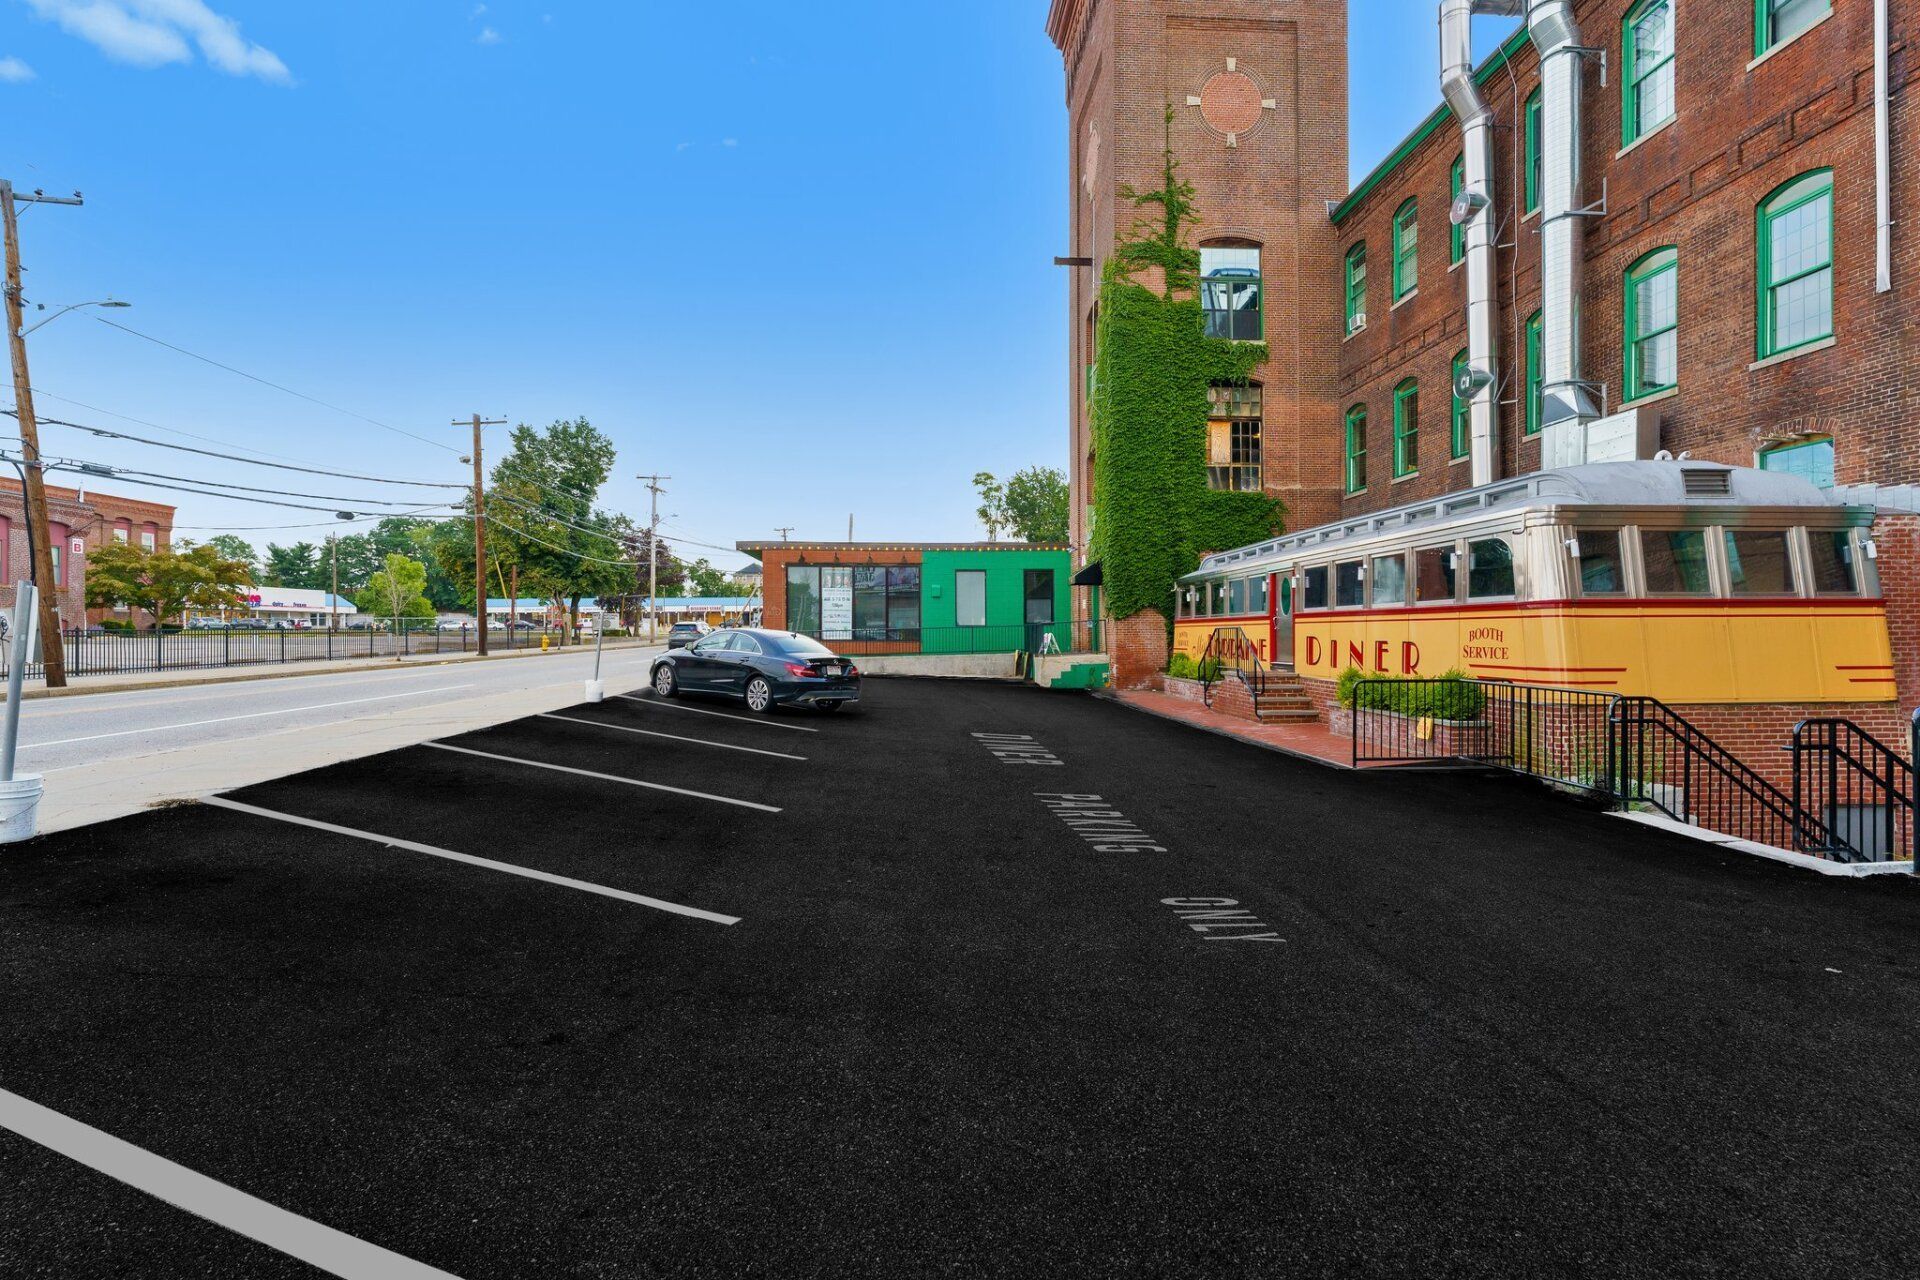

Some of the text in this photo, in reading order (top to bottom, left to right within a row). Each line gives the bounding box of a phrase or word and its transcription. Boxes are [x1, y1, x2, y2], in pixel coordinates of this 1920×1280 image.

[74, 543, 82, 552] B
[1469, 627, 1504, 643] BOOTH
[1306, 636, 1420, 675] DINER
[1462, 645, 1509, 660] SERVICE
[970, 732, 1065, 766] DINER
[1033, 792, 1168, 852] PARKING
[1160, 897, 1287, 942] ONLY
